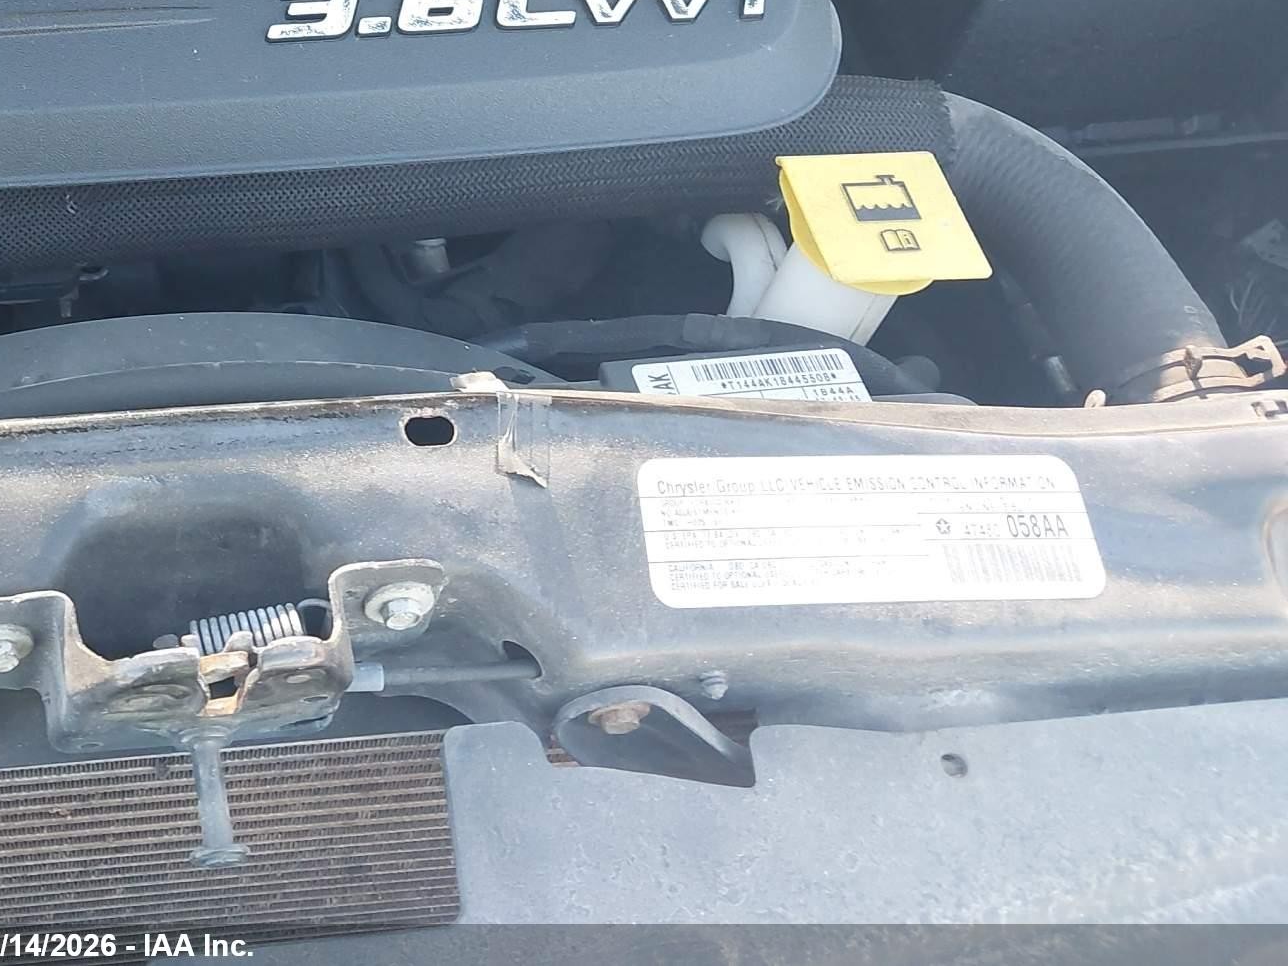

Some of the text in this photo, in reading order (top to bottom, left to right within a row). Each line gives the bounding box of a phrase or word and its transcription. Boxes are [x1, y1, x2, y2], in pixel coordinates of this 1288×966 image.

[657, 479, 711, 497] Chrysler
[715, 478, 756, 494] Group
[762, 478, 785, 492] LLC
[789, 477, 841, 492] VEHICLE
[845, 476, 906, 492] EMISSION
[909, 476, 969, 491] CONTROL
[1005, 513, 1070, 539] 058AA
